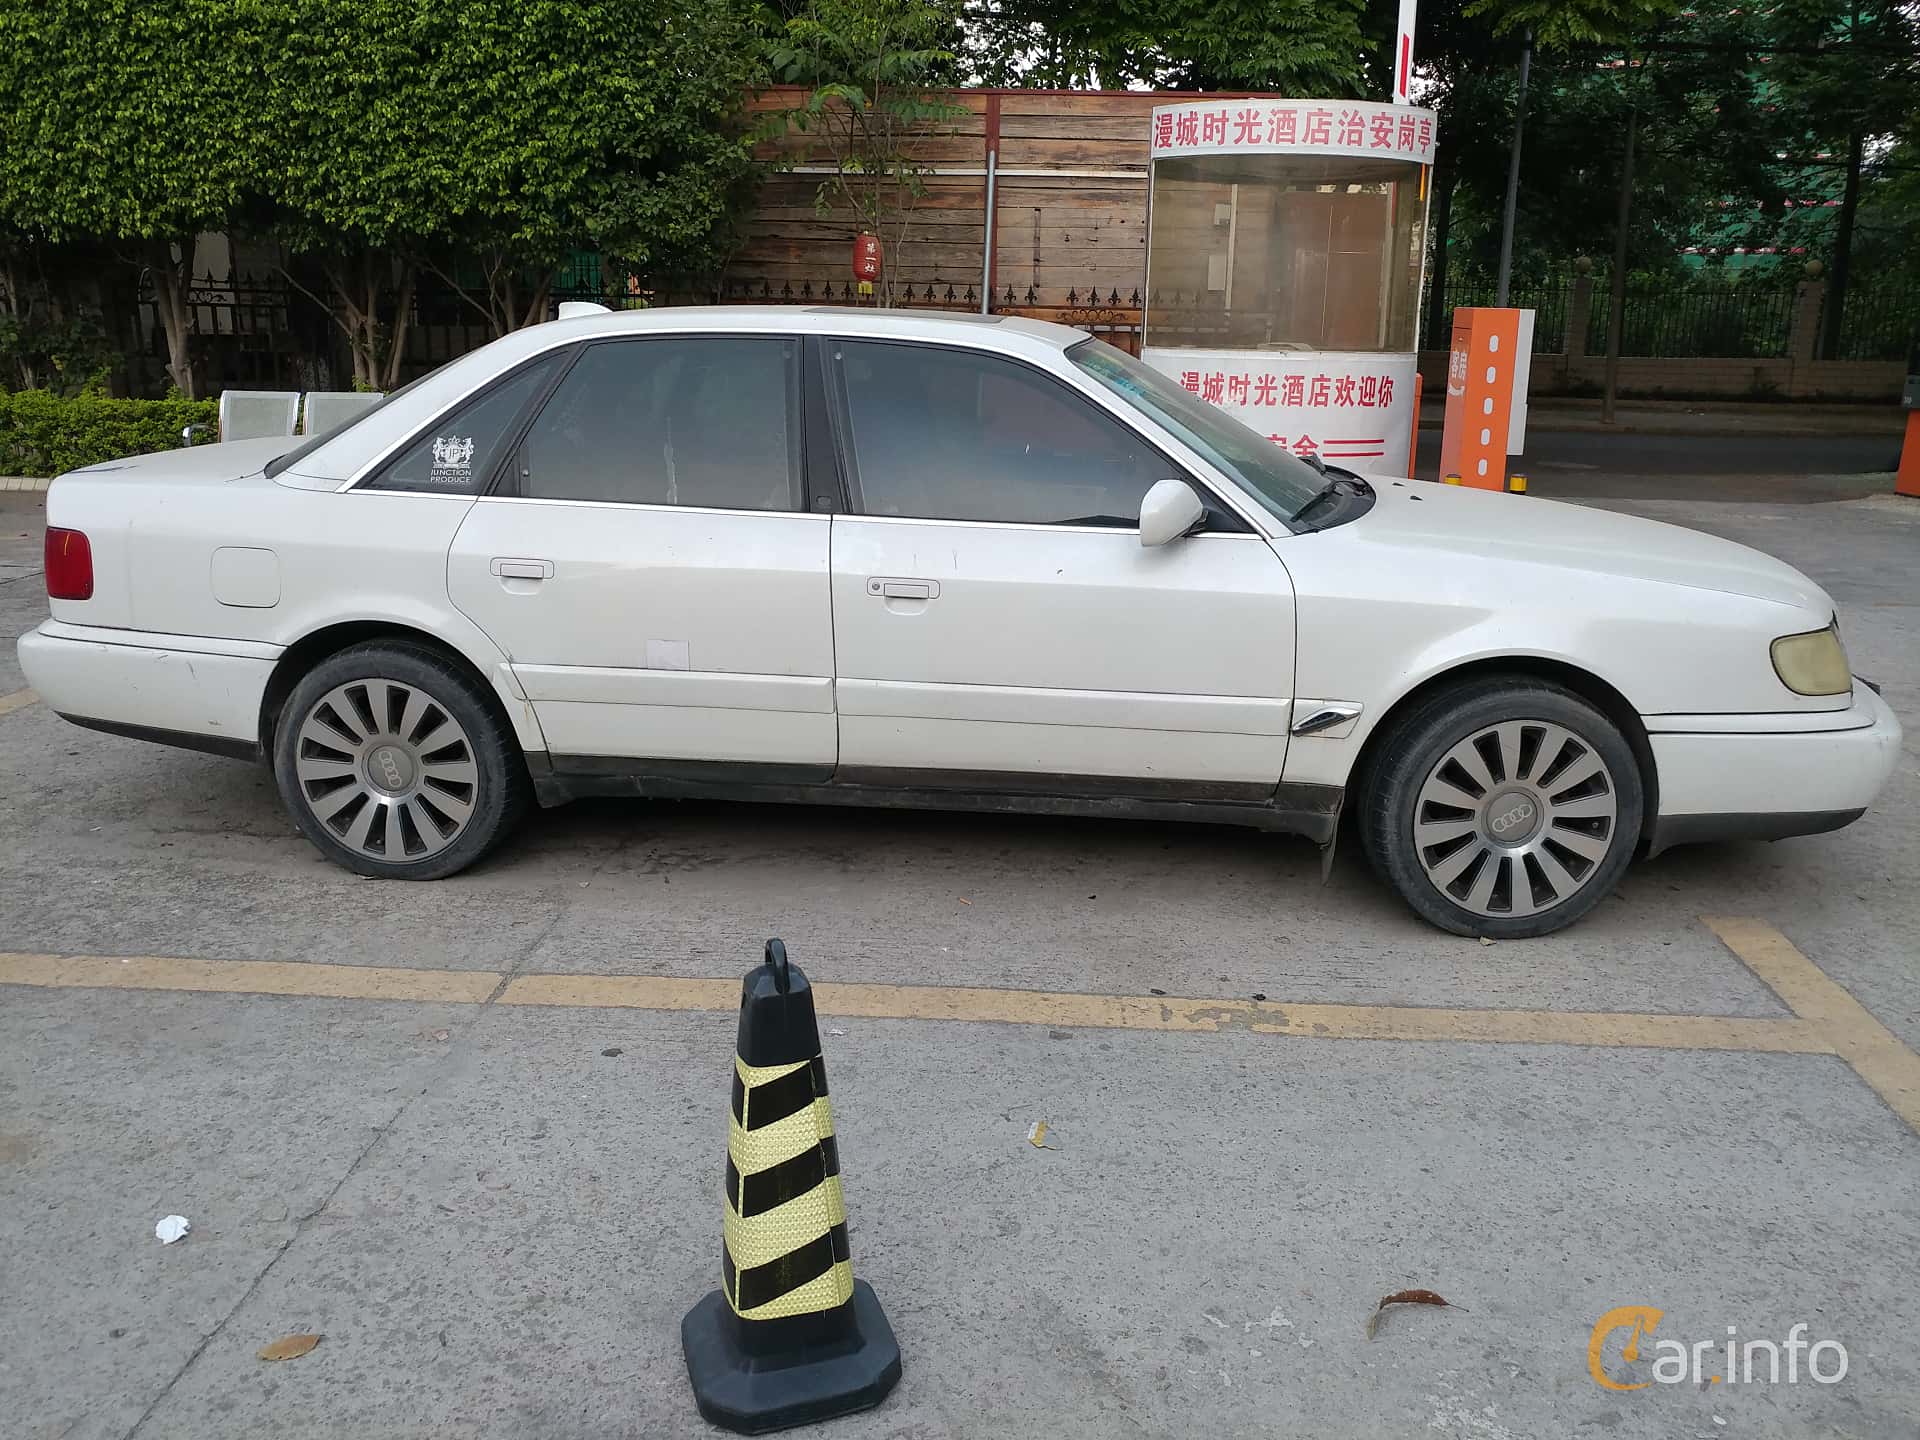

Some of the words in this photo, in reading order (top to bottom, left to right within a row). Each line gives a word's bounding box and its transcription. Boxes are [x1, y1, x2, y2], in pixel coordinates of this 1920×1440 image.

[1154, 107, 1433, 155] 漫城时光酒店治安岗亭
